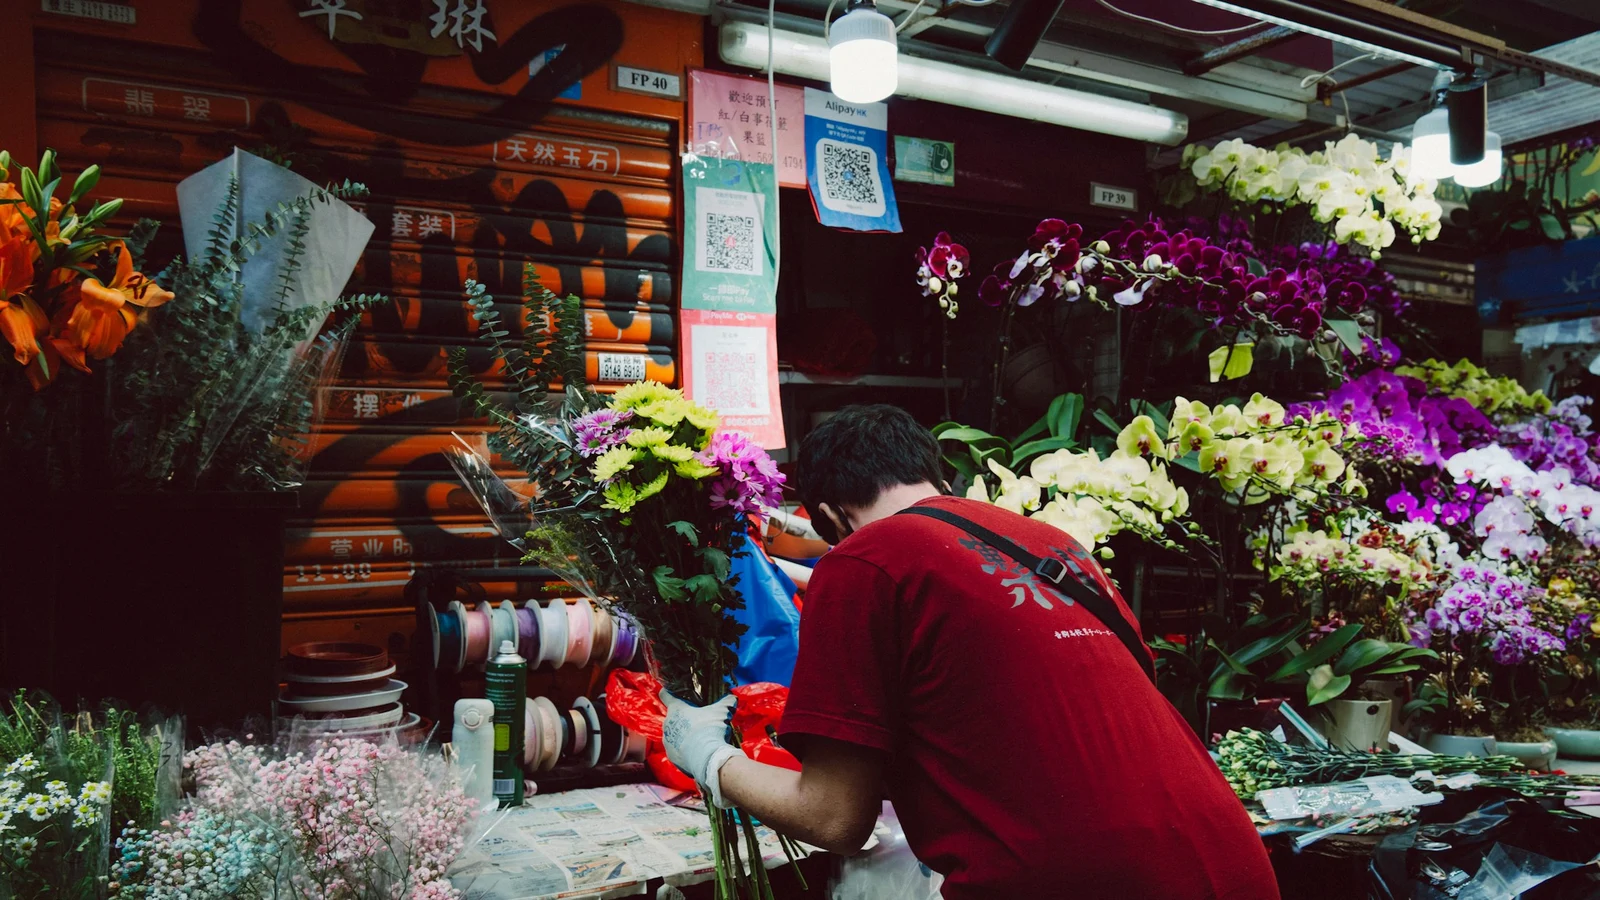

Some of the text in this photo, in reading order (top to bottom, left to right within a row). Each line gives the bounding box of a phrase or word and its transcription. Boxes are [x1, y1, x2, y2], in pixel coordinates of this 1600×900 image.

[630, 72, 668, 90] FP 40
[124, 89, 211, 121] 翡翠
[505, 139, 609, 172] 天然玉石
[1102, 191, 1126, 204] FP 39
[604, 364, 640, 378] 9148 6918
[295, 562, 372, 582] 11:00
